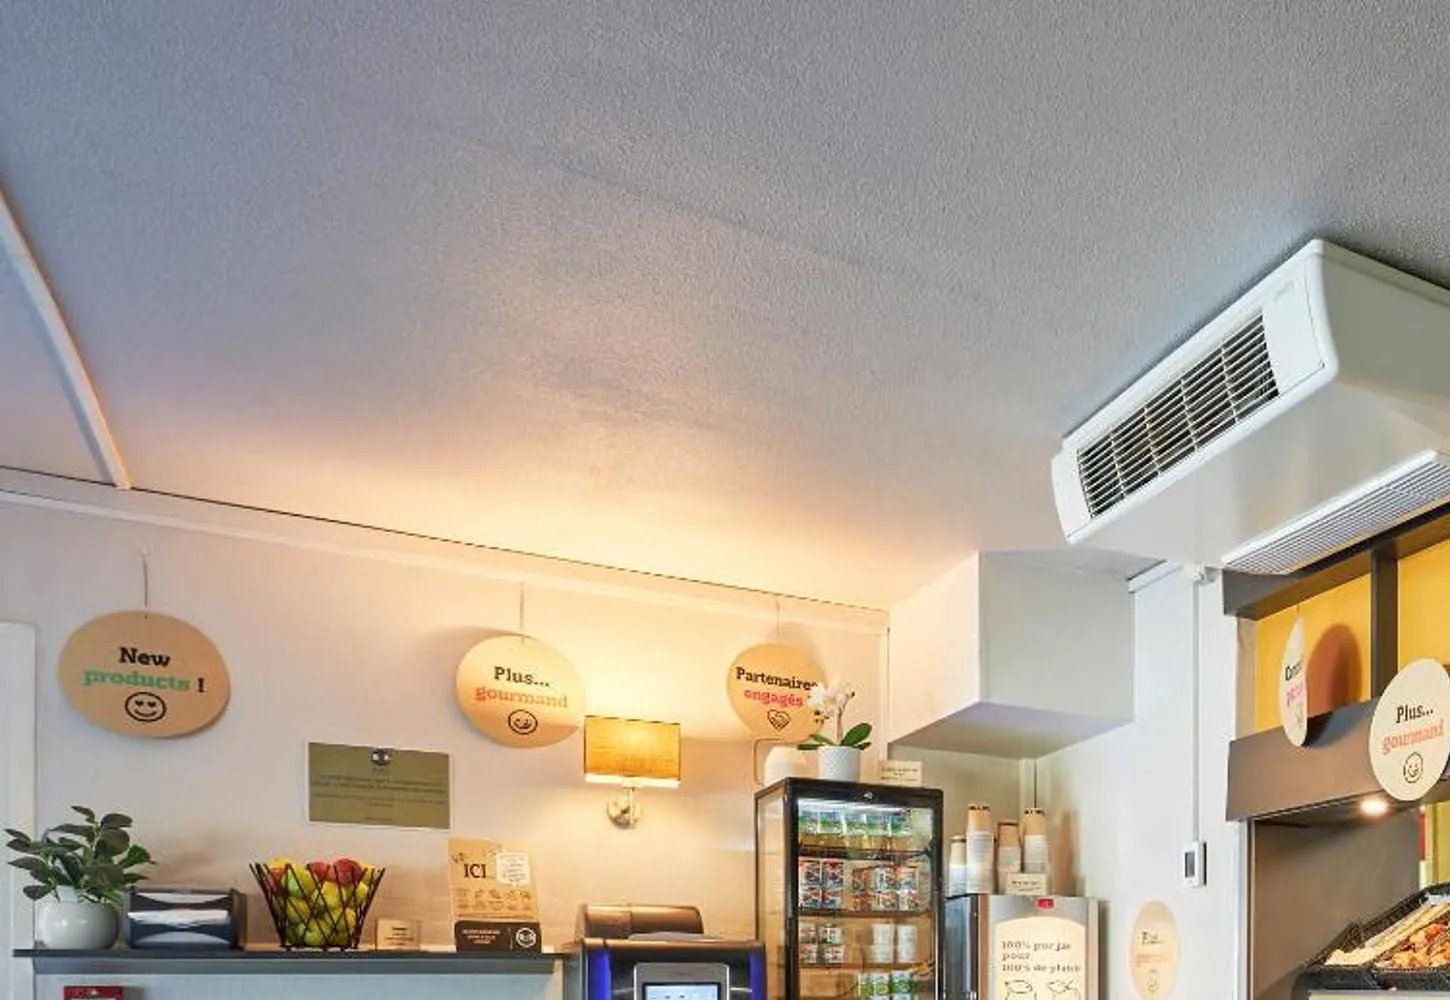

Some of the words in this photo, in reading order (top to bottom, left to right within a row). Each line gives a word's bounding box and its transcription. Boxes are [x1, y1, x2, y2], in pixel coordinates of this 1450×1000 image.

[119, 646, 171, 668] New
[83, 669, 190, 692] products
[494, 666, 550, 687] Plus...
[474, 686, 568, 708] gourmand
[1395, 704, 1433, 724] Plus...
[1382, 717, 1445, 756] gourmand
[463, 863, 487, 878] ICI
